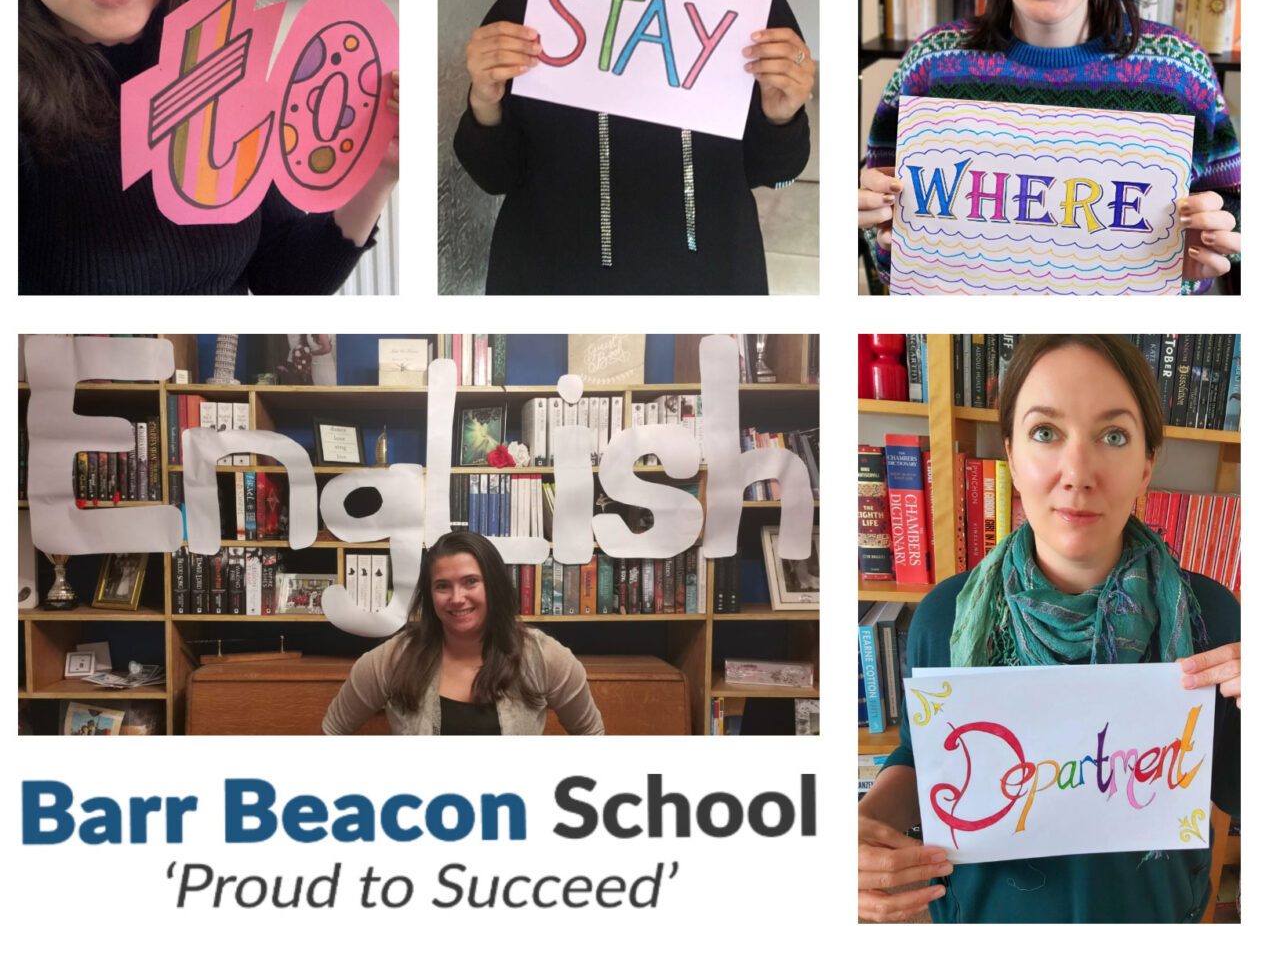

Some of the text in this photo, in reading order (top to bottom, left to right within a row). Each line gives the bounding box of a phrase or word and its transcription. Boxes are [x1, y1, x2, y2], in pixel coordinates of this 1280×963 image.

[906, 156, 1153, 234] WHERE
[1149, 343, 1157, 363] KATE
[975, 371, 983, 393] HUXLEY
[1176, 364, 1190, 406] Dissolution
[971, 465, 979, 505] PYNCHON
[984, 477, 995, 491] KIM
[862, 519, 879, 527] LIFE
[984, 492, 995, 518] GORDON
[890, 493, 906, 566] DICTIONARY
[905, 493, 921, 566] CHAMBERS
[984, 519, 996, 532] GIRL
[862, 630, 877, 699] FEARNE COTTON
[929, 703, 1208, 851] Department
